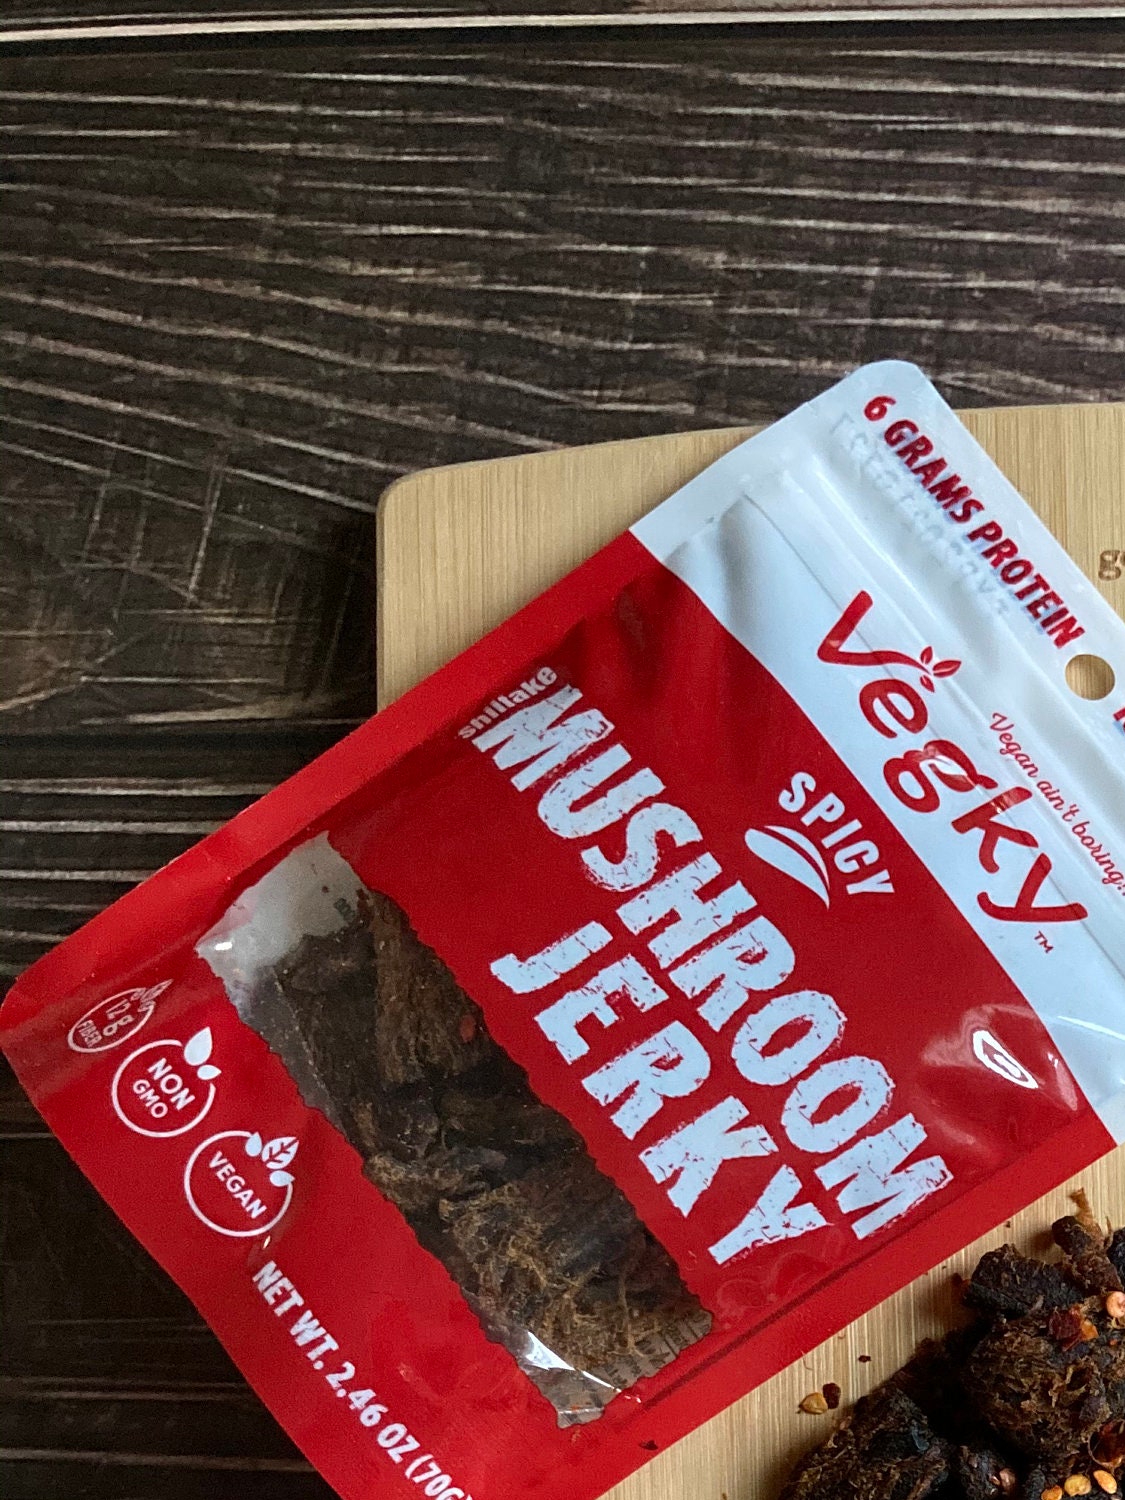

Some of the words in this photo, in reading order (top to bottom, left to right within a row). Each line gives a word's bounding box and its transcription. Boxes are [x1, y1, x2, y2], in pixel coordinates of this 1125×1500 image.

[864, 395, 896, 421] 6
[884, 419, 985, 523] GRAMS
[967, 520, 1086, 649] PROTEIN
[817, 589, 1088, 922] Vegky
[990, 712, 1039, 779] Vegan
[1036, 779, 1078, 823] ain't
[778, 770, 895, 896] SPICY
[472, 682, 954, 1240] MUSHROOM
[78, 1018, 103, 1049] FIBER
[147, 1057, 196, 1110] NON
[490, 920, 834, 1265] JERKY
[132, 1079, 168, 1118] GMO
[208, 1151, 267, 1219] VEGAN
[252, 1260, 304, 1317] NET
[289, 1309, 340, 1370] WT.
[325, 1361, 389, 1427] 2.46
[377, 1423, 420, 1464] OZ
